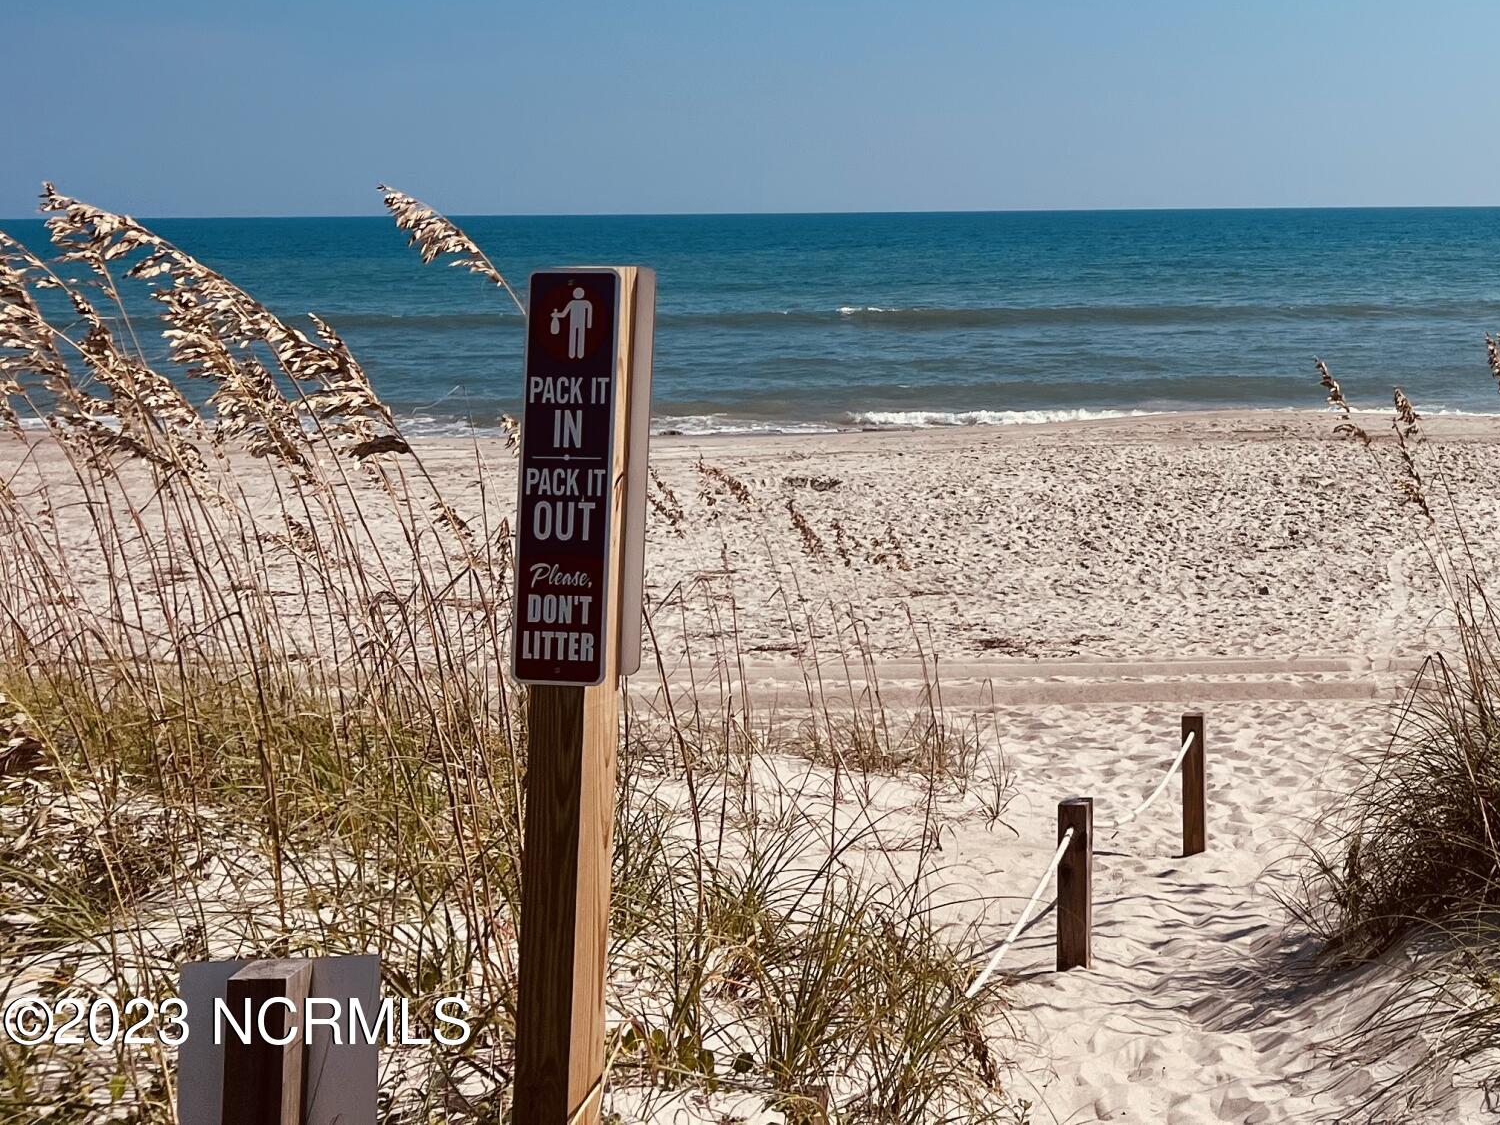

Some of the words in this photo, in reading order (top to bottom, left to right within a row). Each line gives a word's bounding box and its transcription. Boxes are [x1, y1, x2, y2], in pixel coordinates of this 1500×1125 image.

[529, 376, 583, 404] PACK
[591, 377, 610, 405] IT
[553, 409, 583, 448] IN
[525, 467, 580, 496] PACK
[587, 469, 606, 497] IT
[533, 500, 596, 541] OUT
[529, 562, 593, 589] Please,
[527, 593, 593, 625] DON'T
[522, 630, 595, 662] LITTER
